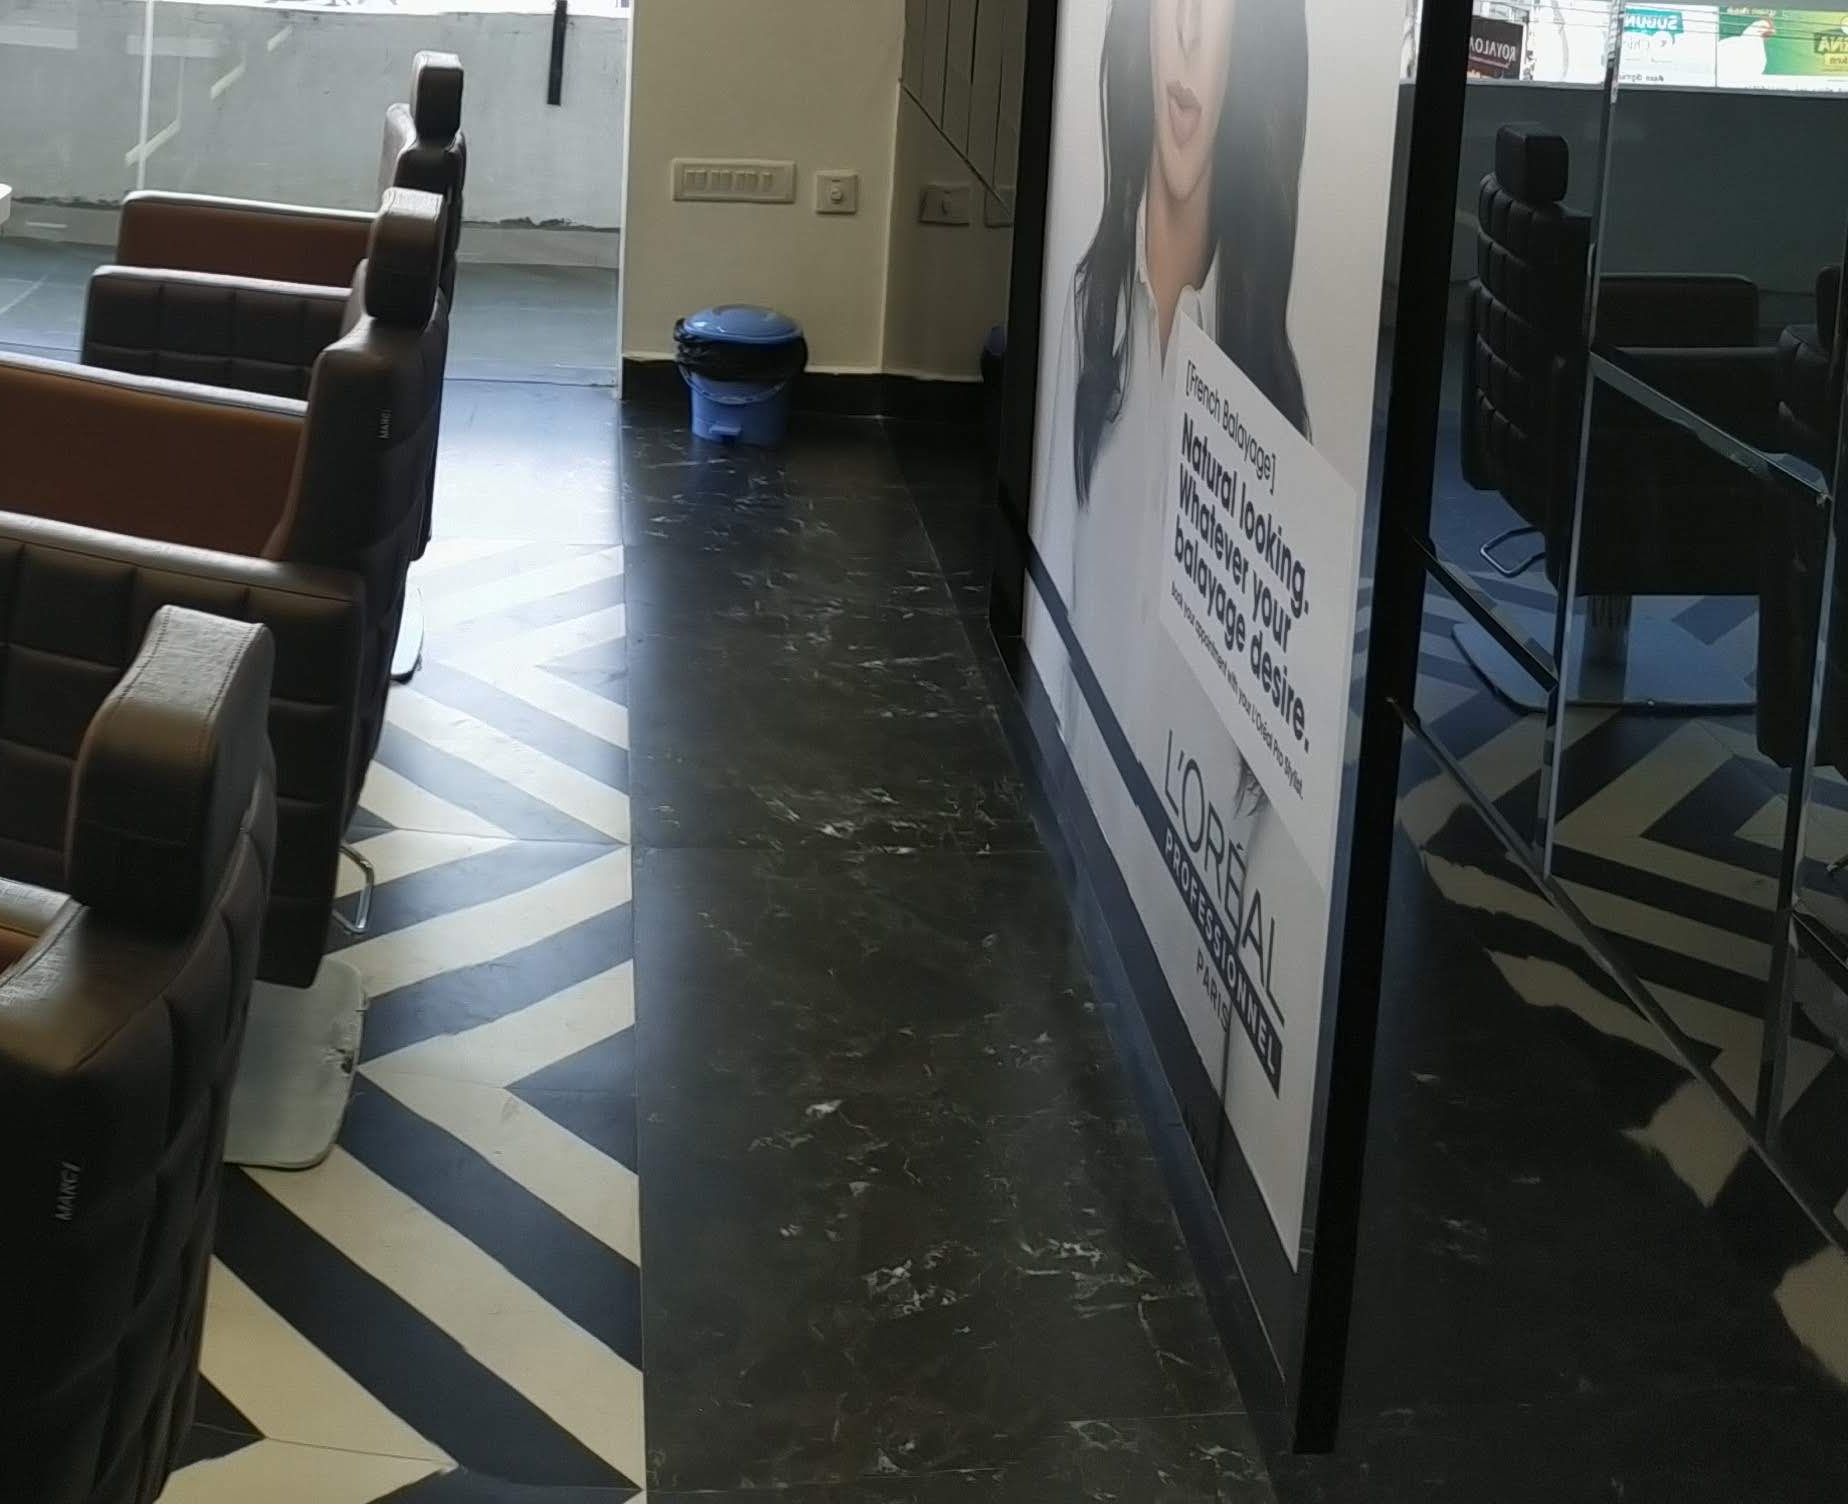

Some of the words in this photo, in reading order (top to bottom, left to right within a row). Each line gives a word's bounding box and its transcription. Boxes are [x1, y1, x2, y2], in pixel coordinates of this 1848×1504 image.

[1181, 412, 1237, 518] Natural
[1239, 481, 1309, 619] looking.
[1185, 359, 1221, 424] [French
[1222, 399, 1276, 495] Balayage]
[1174, 513, 1246, 652] balayage
[1250, 630, 1310, 754] desire.
[1179, 462, 1249, 594] Whatever
[1252, 569, 1292, 653] your
[1238, 687, 1252, 717] your
[1273, 738, 1284, 768] Pro
[1164, 728, 1285, 1028] L'ORÉAL
[1165, 827, 1276, 1076] PROFESSIONNEL
[1196, 944, 1231, 1034] PARIS
